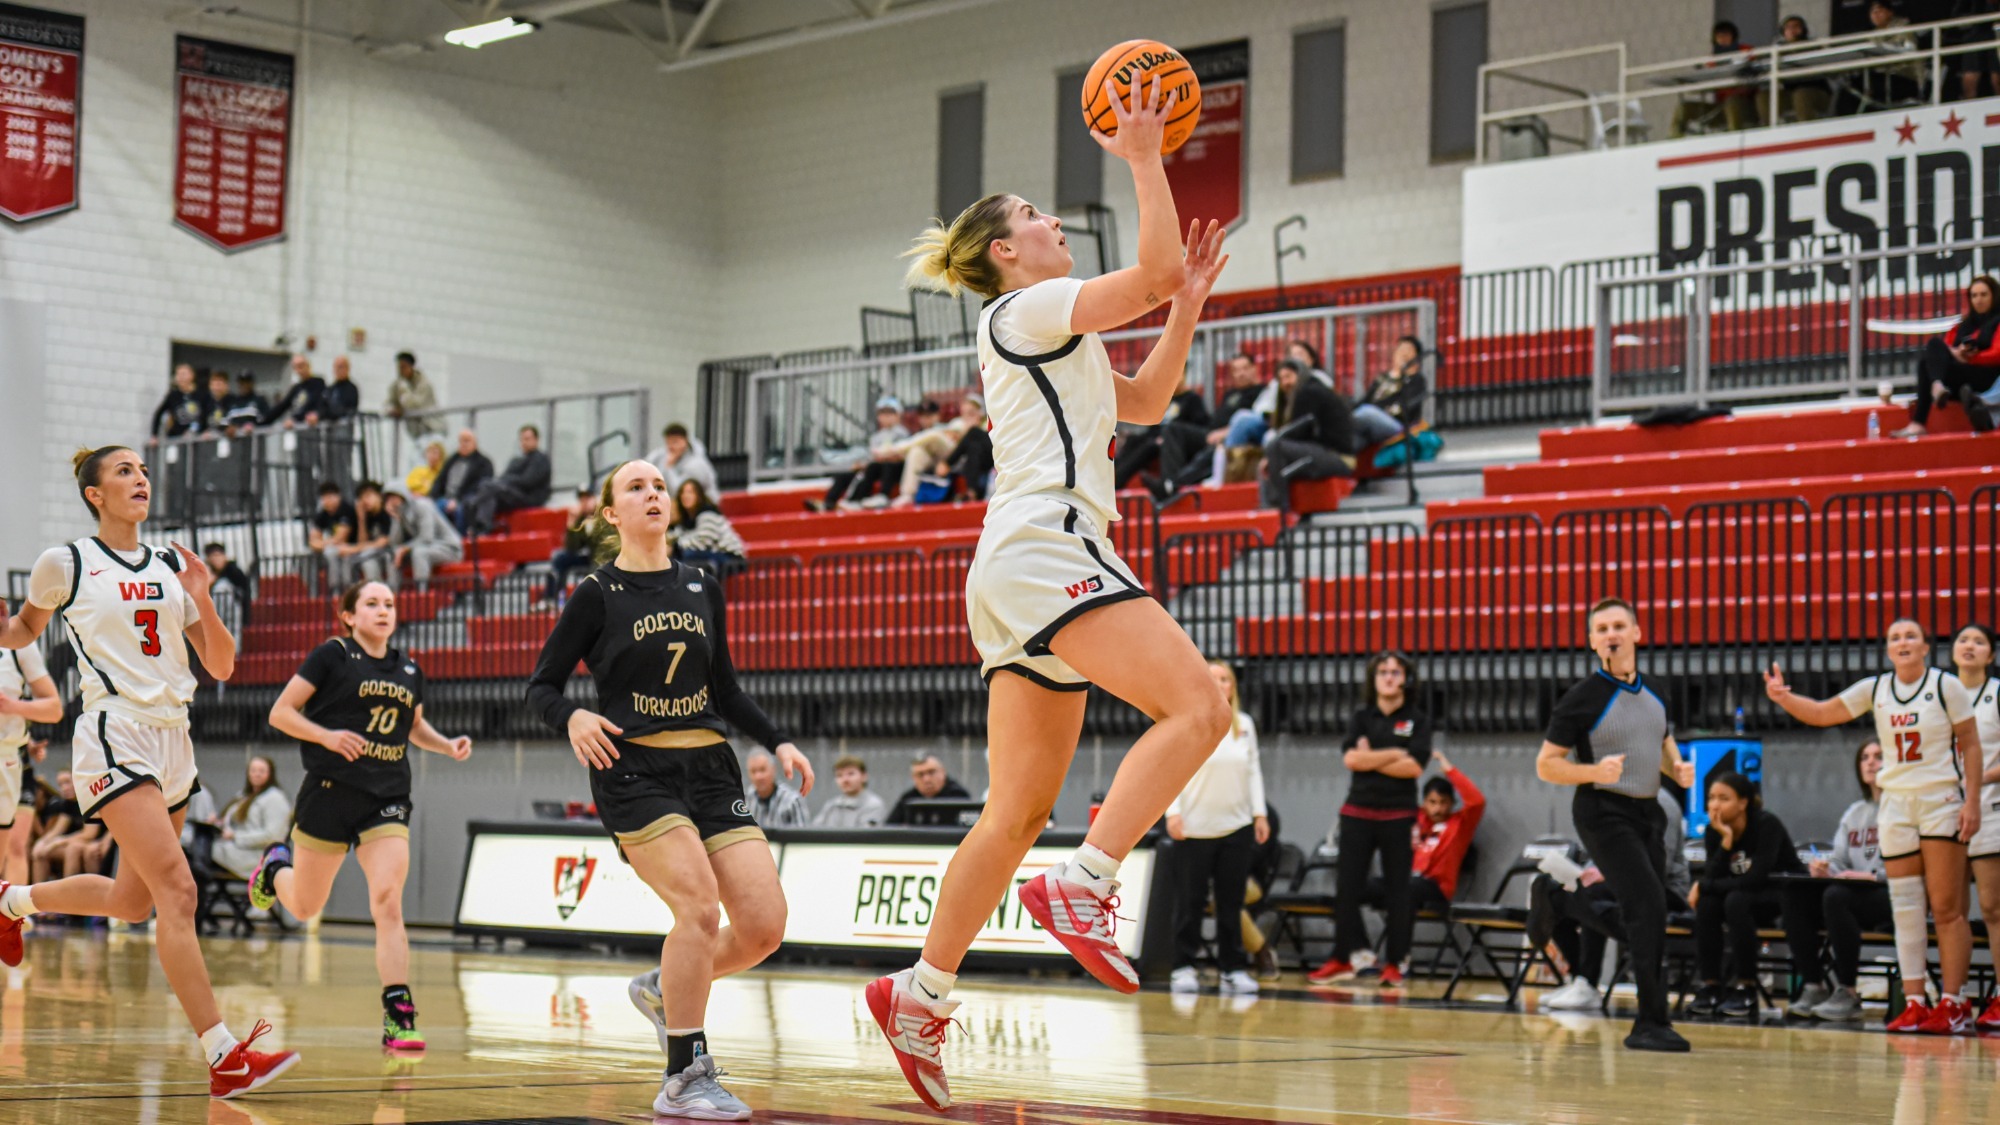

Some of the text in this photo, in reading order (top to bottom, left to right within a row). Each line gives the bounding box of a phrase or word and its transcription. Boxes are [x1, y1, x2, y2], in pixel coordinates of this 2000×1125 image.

[0, 23, 80, 48] RESIDENTS
[0, 46, 64, 74] OMEN'S
[0, 66, 45, 87] GOLF
[0, 89, 74, 114] HAMPIONS
[134, 609, 161, 656] 3
[633, 611, 706, 641] GOLDEN
[664, 641, 687, 684] 7
[359, 680, 414, 708] GOLDEN
[632, 685, 708, 717] TORNADOES
[366, 705, 399, 735] 10
[1894, 731, 1923, 763] 12
